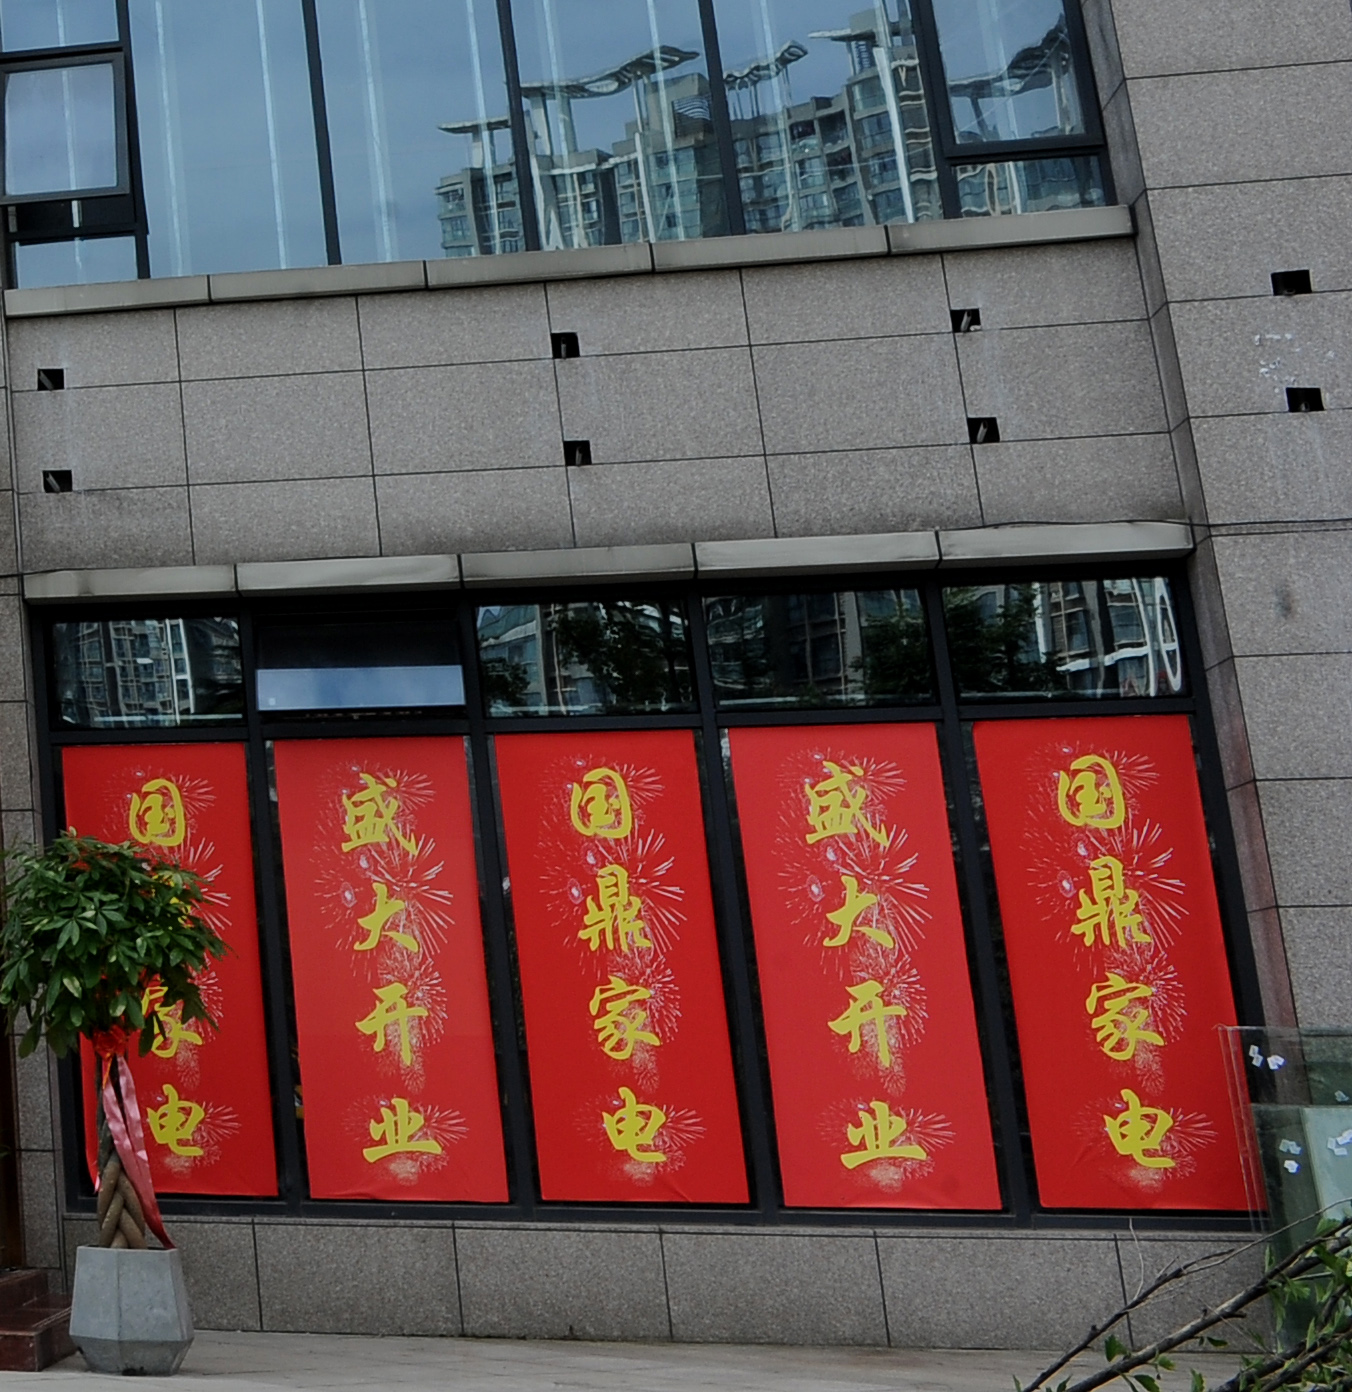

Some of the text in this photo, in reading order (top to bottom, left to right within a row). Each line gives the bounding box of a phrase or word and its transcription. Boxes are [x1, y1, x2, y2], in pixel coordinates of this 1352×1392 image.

[129, 778, 205, 1157] 国家电
[342, 773, 443, 1164] 盛大开业
[570, 768, 667, 1163] 国鼎家电
[805, 761, 927, 1170] 盛大开业
[1057, 754, 1176, 1170] 国鼎家电
